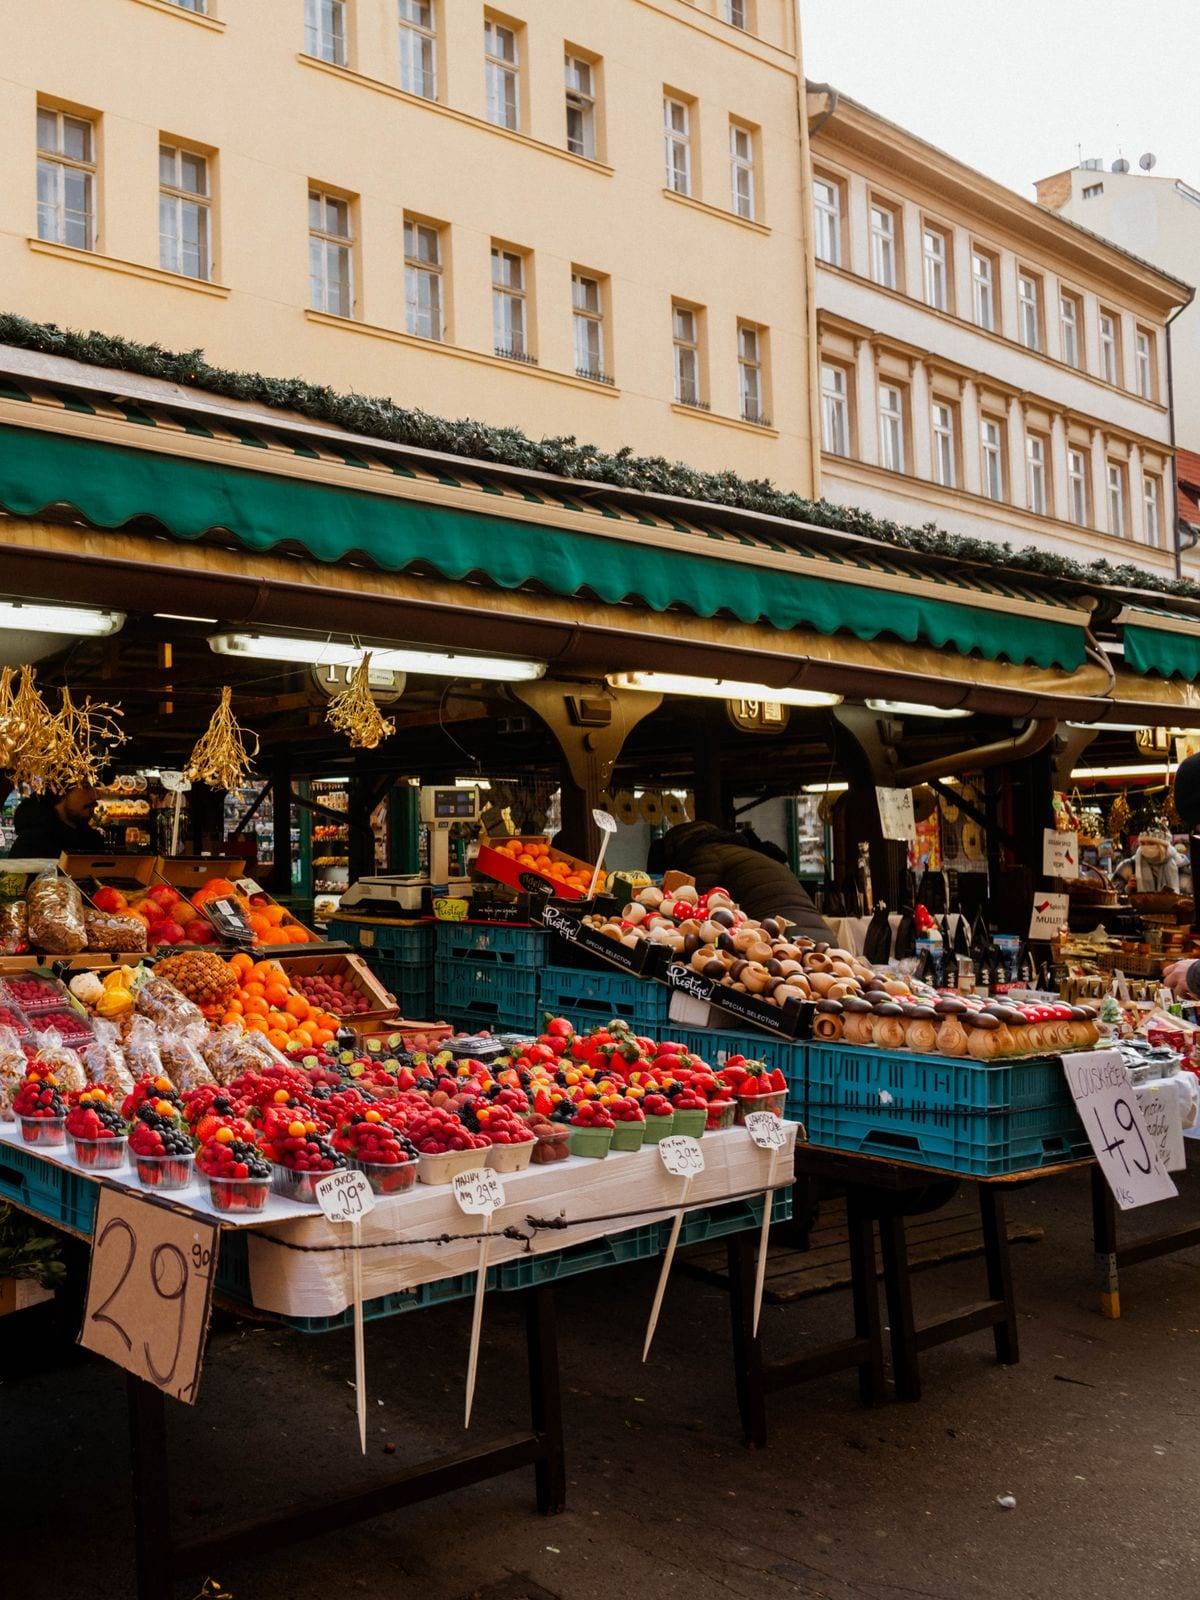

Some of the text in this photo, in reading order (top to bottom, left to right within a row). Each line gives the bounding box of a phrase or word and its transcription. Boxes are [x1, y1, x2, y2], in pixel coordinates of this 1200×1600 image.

[740, 698, 759, 719] 19
[542, 906, 577, 940] Prestige
[586, 939, 632, 966] SPECIAL SELECTION
[666, 965, 712, 1001] Prestige
[722, 998, 780, 1027] SPECIAL SELECTION
[320, 1181, 333, 1197] MIX
[337, 1185, 363, 1215] 29
[476, 1183, 493, 1206] 39
[91, 1217, 189, 1386] 29
